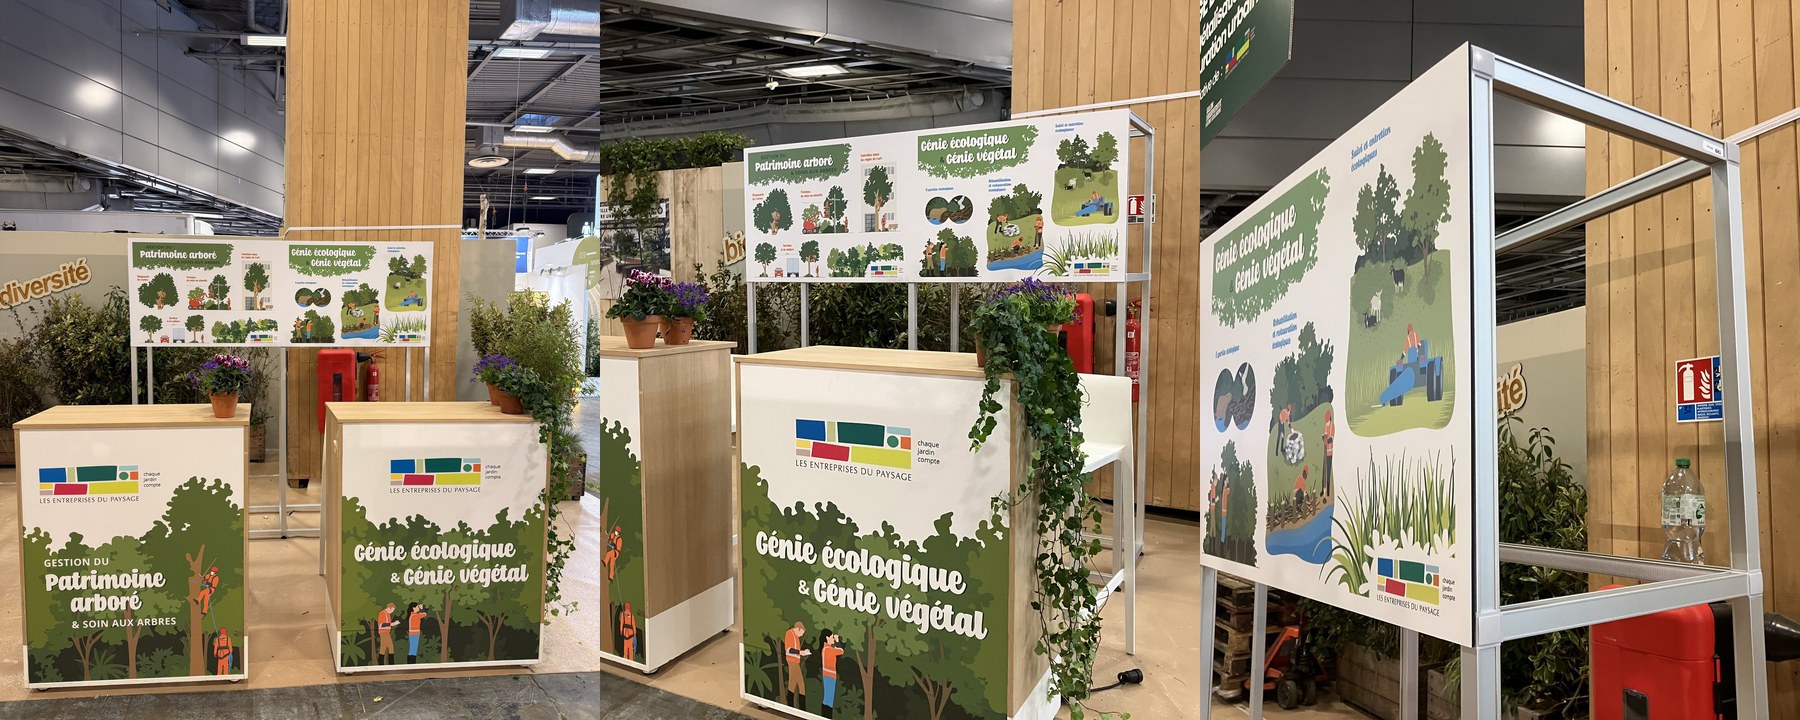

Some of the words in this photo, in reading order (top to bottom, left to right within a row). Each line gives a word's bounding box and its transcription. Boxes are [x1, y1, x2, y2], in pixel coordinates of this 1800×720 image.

[921, 137, 948, 152] Génie
[950, 133, 1010, 149] écologique
[755, 158, 802, 172] Patrimoine
[803, 154, 833, 168] arboré
[946, 150, 975, 165] Génie
[976, 147, 1017, 164] végétal
[1215, 239, 1238, 274] Génie
[1239, 204, 1297, 259] écologique
[140, 250, 188, 259] Patrimoine
[189, 251, 218, 260] arboré
[291, 247, 313, 257] Génie
[313, 248, 357, 258] écologique
[311, 258, 332, 267] Génie
[333, 258, 362, 268] végétal
[1235, 259, 1261, 294] Génie
[1263, 233, 1305, 281] végétal
[0, 259, 89, 306] diversité
[917, 440, 940, 449] chaque
[917, 448, 935, 456] jardin
[917, 456, 941, 465] compte
[795, 459, 808, 468] LES
[809, 460, 858, 475] ENTREPRISES
[860, 467, 873, 477] DU
[876, 469, 912, 482] PAYSAGE
[53, 496, 96, 504] ENTREPRISES
[354, 540, 407, 562] Génie
[410, 539, 516, 564] écologique
[44, 558, 90, 567] GESTION
[94, 557, 109, 566] DU
[755, 530, 818, 565] Génie
[821, 540, 967, 595] écologique
[45, 568, 166, 592] Patrimoine
[390, 572, 400, 583] &
[403, 565, 456, 586] Génie
[459, 563, 530, 588] végétal
[1442, 577, 1455, 586] chaque
[70, 591, 142, 613] arboré
[1384, 596, 1410, 609] ENTREPRISES
[1411, 602, 1419, 611] DU
[1419, 604, 1440, 617] PAYSAGE
[1442, 593, 1456, 602] compte
[798, 579, 810, 596] &
[813, 577, 880, 615] Génie
[885, 593, 988, 640] végétal
[72, 621, 80, 629] &
[83, 620, 109, 629] SOIN
[112, 619, 134, 628] AUX
[137, 617, 177, 627] ARBRES
